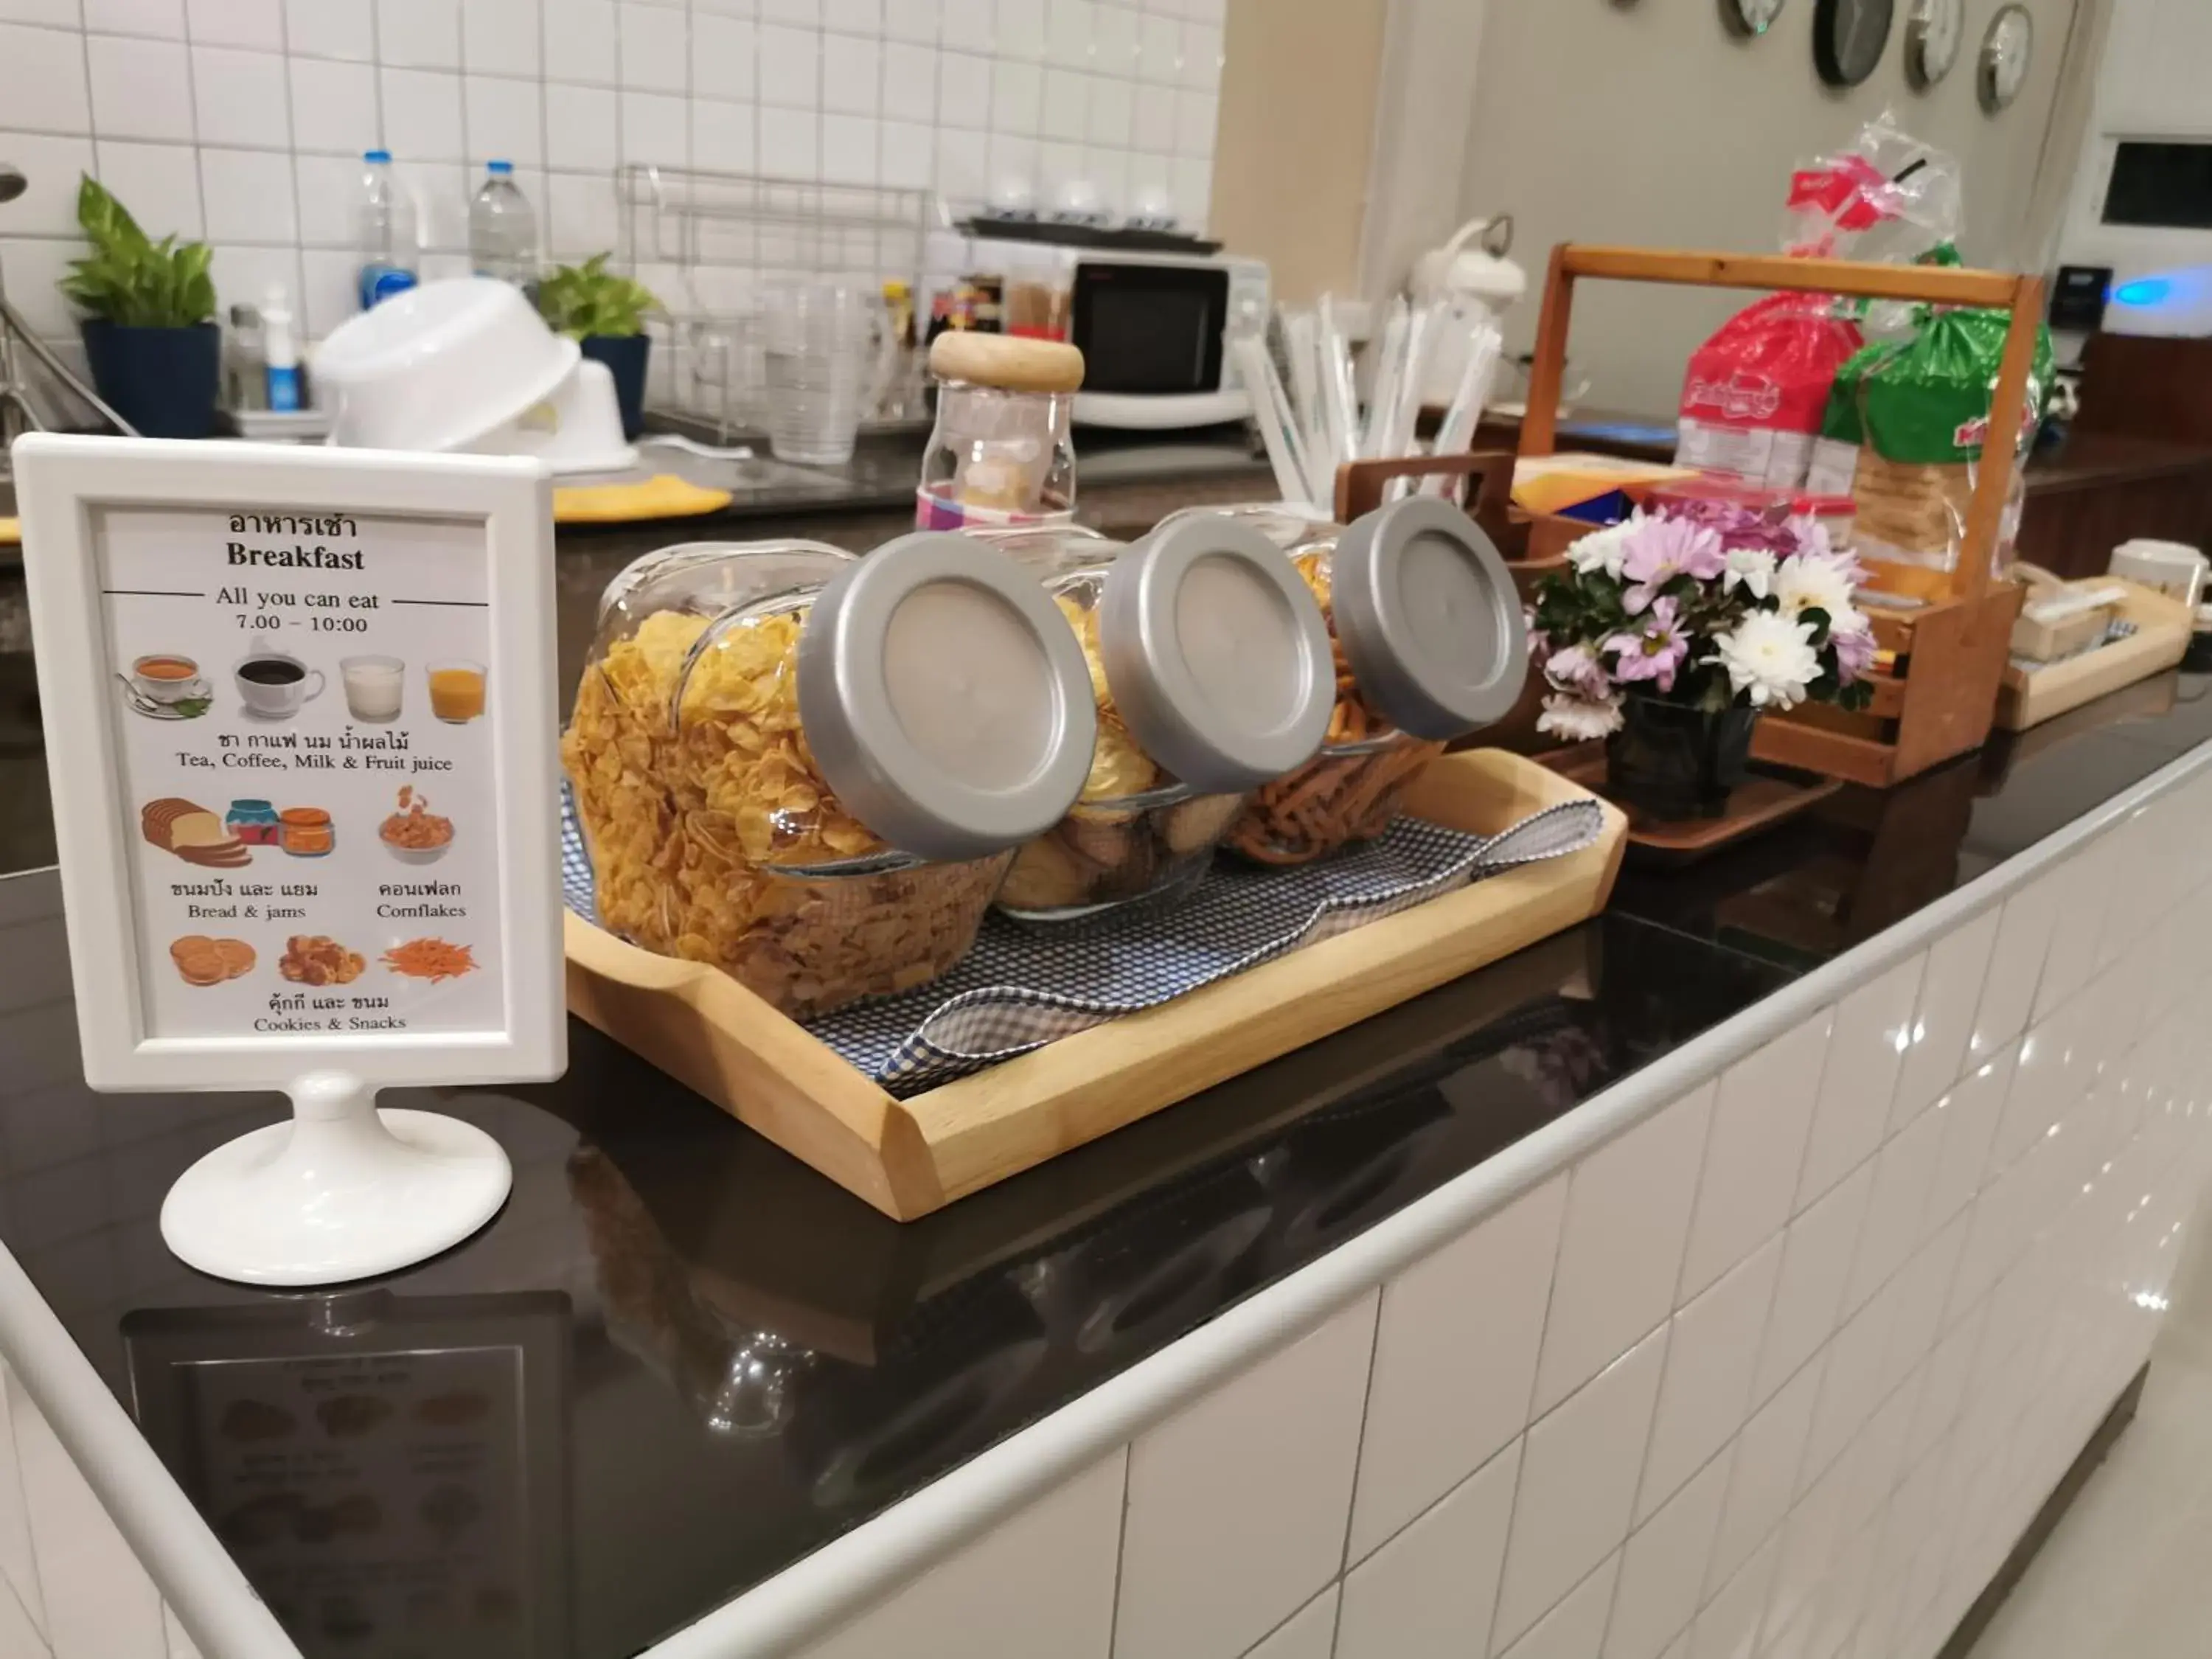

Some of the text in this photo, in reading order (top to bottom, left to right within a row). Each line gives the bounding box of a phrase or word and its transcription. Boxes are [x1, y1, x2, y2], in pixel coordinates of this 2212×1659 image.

[229, 512, 357, 537] อาหารเช้า
[226, 542, 365, 570] Breakfast
[216, 587, 379, 610] All you can eat
[236, 613, 281, 630] 7.00
[310, 616, 368, 633] 10:00
[248, 732, 296, 748] กาแฟ
[304, 736, 331, 748] นม
[338, 725, 409, 750] น้ำผลไม้
[175, 752, 453, 773] Tea, Coffee, Milk & Fruit juice
[240, 884, 274, 897] และ
[280, 884, 318, 897] แยม
[379, 879, 461, 897] คอนเฟลก
[189, 904, 307, 922] Bread & jams
[376, 903, 467, 918] Cornflakes
[312, 998, 345, 1010] และ
[254, 1015, 407, 1032] Cookies & Snacks
